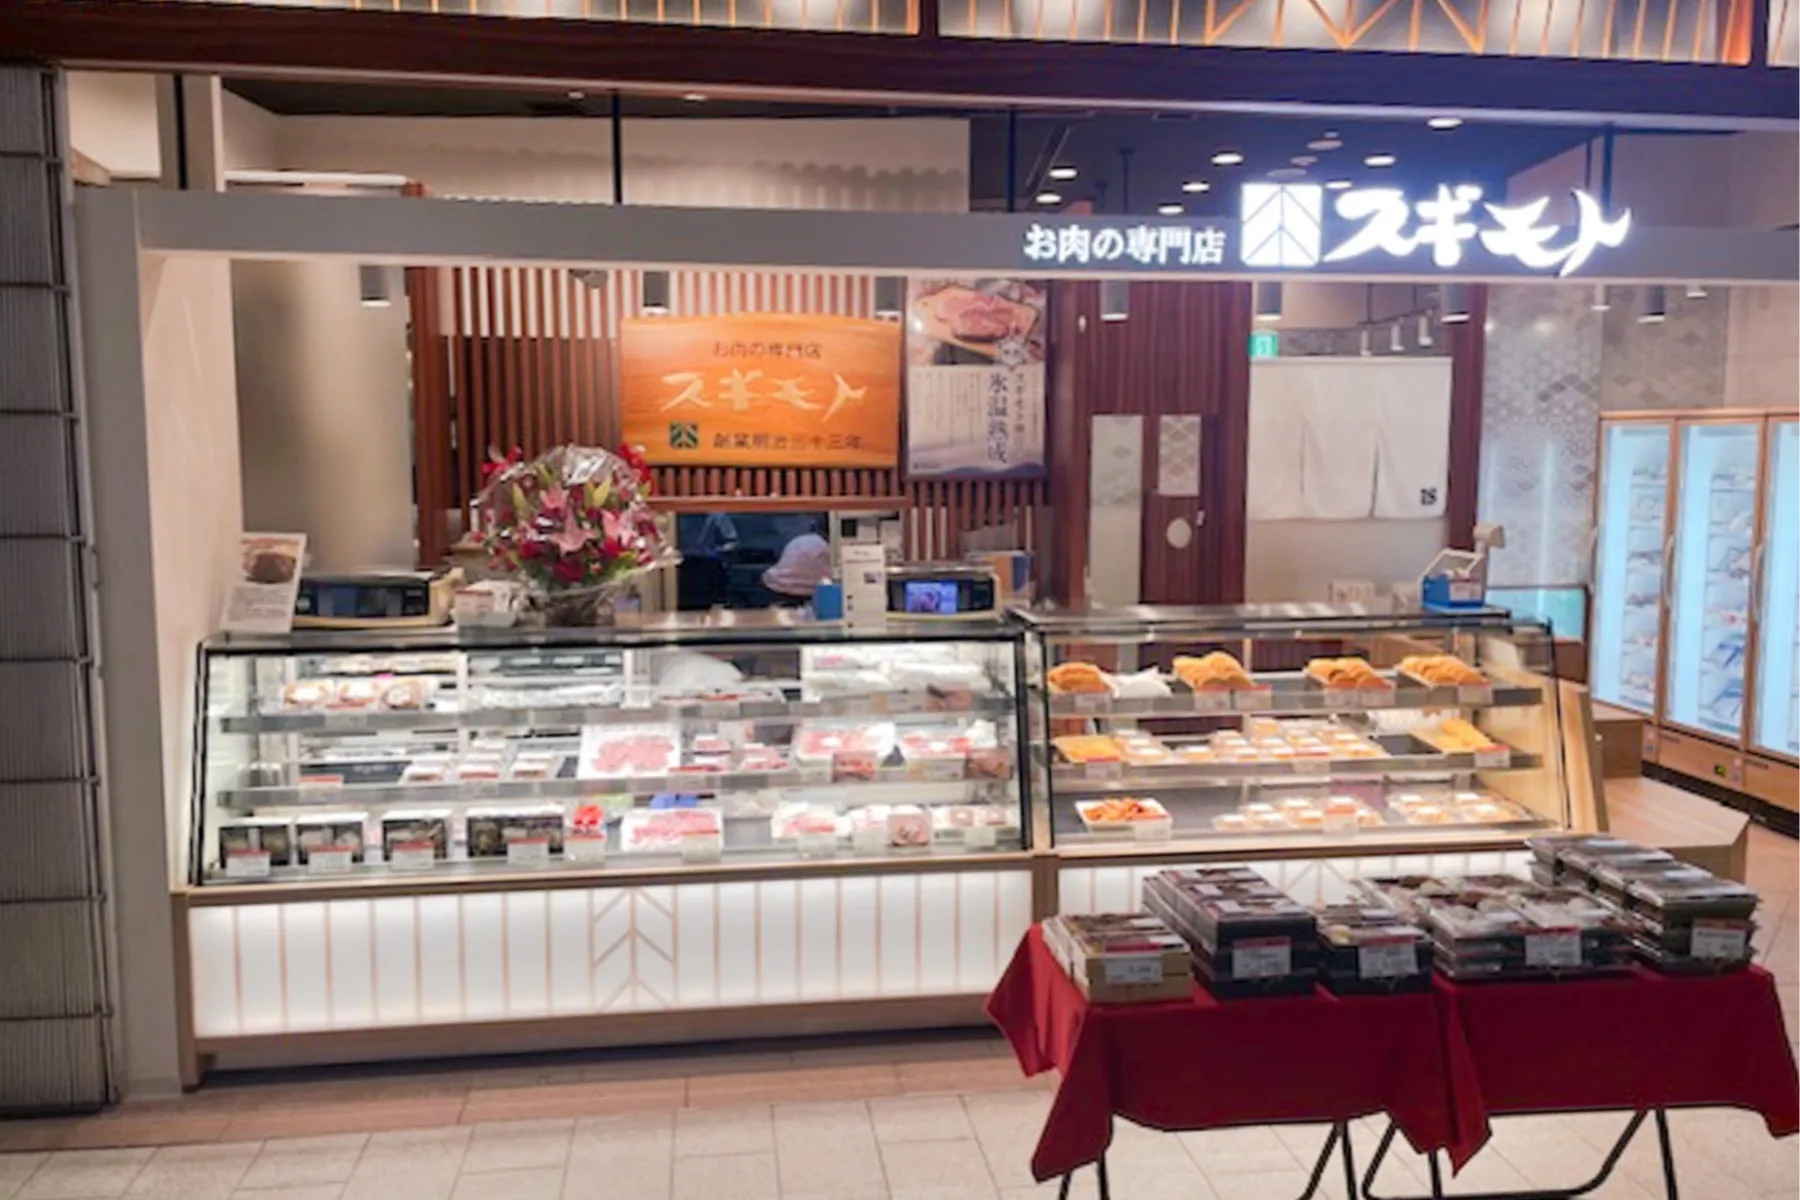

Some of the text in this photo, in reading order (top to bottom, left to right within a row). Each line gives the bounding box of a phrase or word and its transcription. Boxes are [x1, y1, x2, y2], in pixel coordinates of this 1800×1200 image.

[1024, 223, 1226, 265] お肉の専門店
[1323, 184, 1632, 277] スギモト
[660, 368, 868, 422] スギモト
